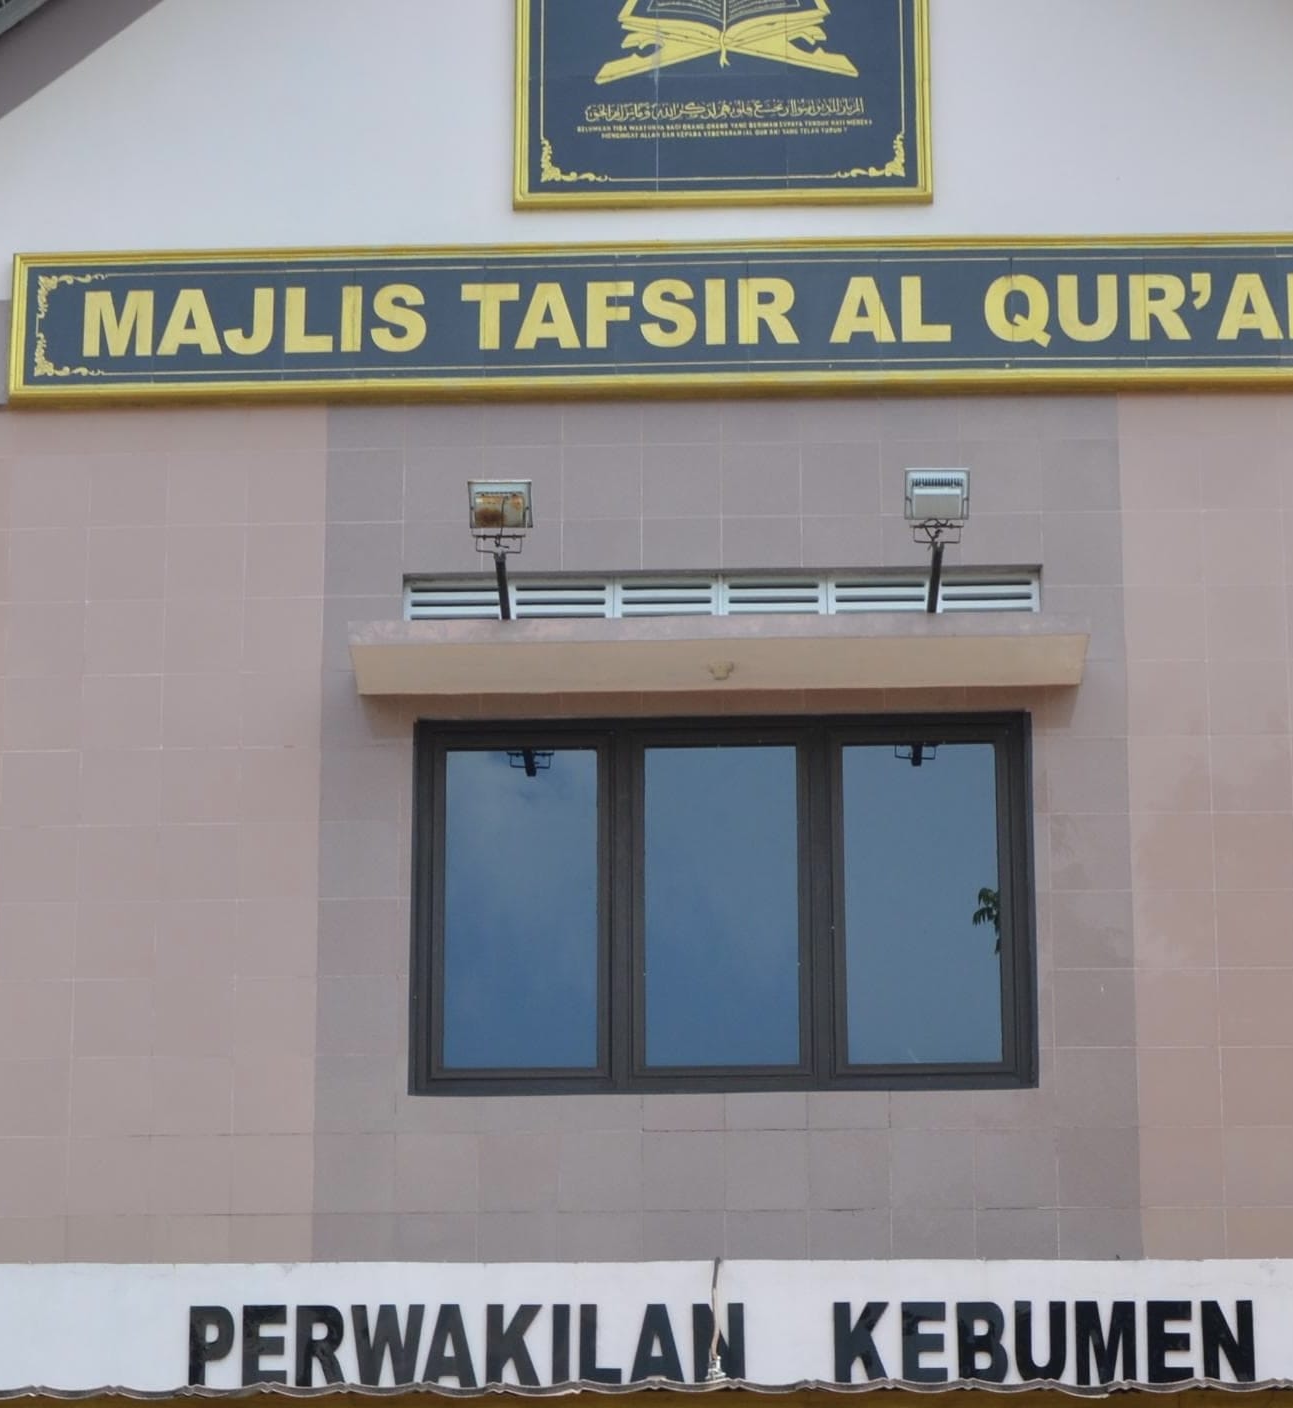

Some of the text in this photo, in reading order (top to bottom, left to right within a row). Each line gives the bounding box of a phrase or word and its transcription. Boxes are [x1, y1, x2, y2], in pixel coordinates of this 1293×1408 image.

[82, 283, 427, 357] MAJLIS
[460, 275, 799, 352] TAFSIR
[830, 273, 952, 345] AL
[188, 1299, 1256, 1388] PERWAKILAN KEBUMEN
